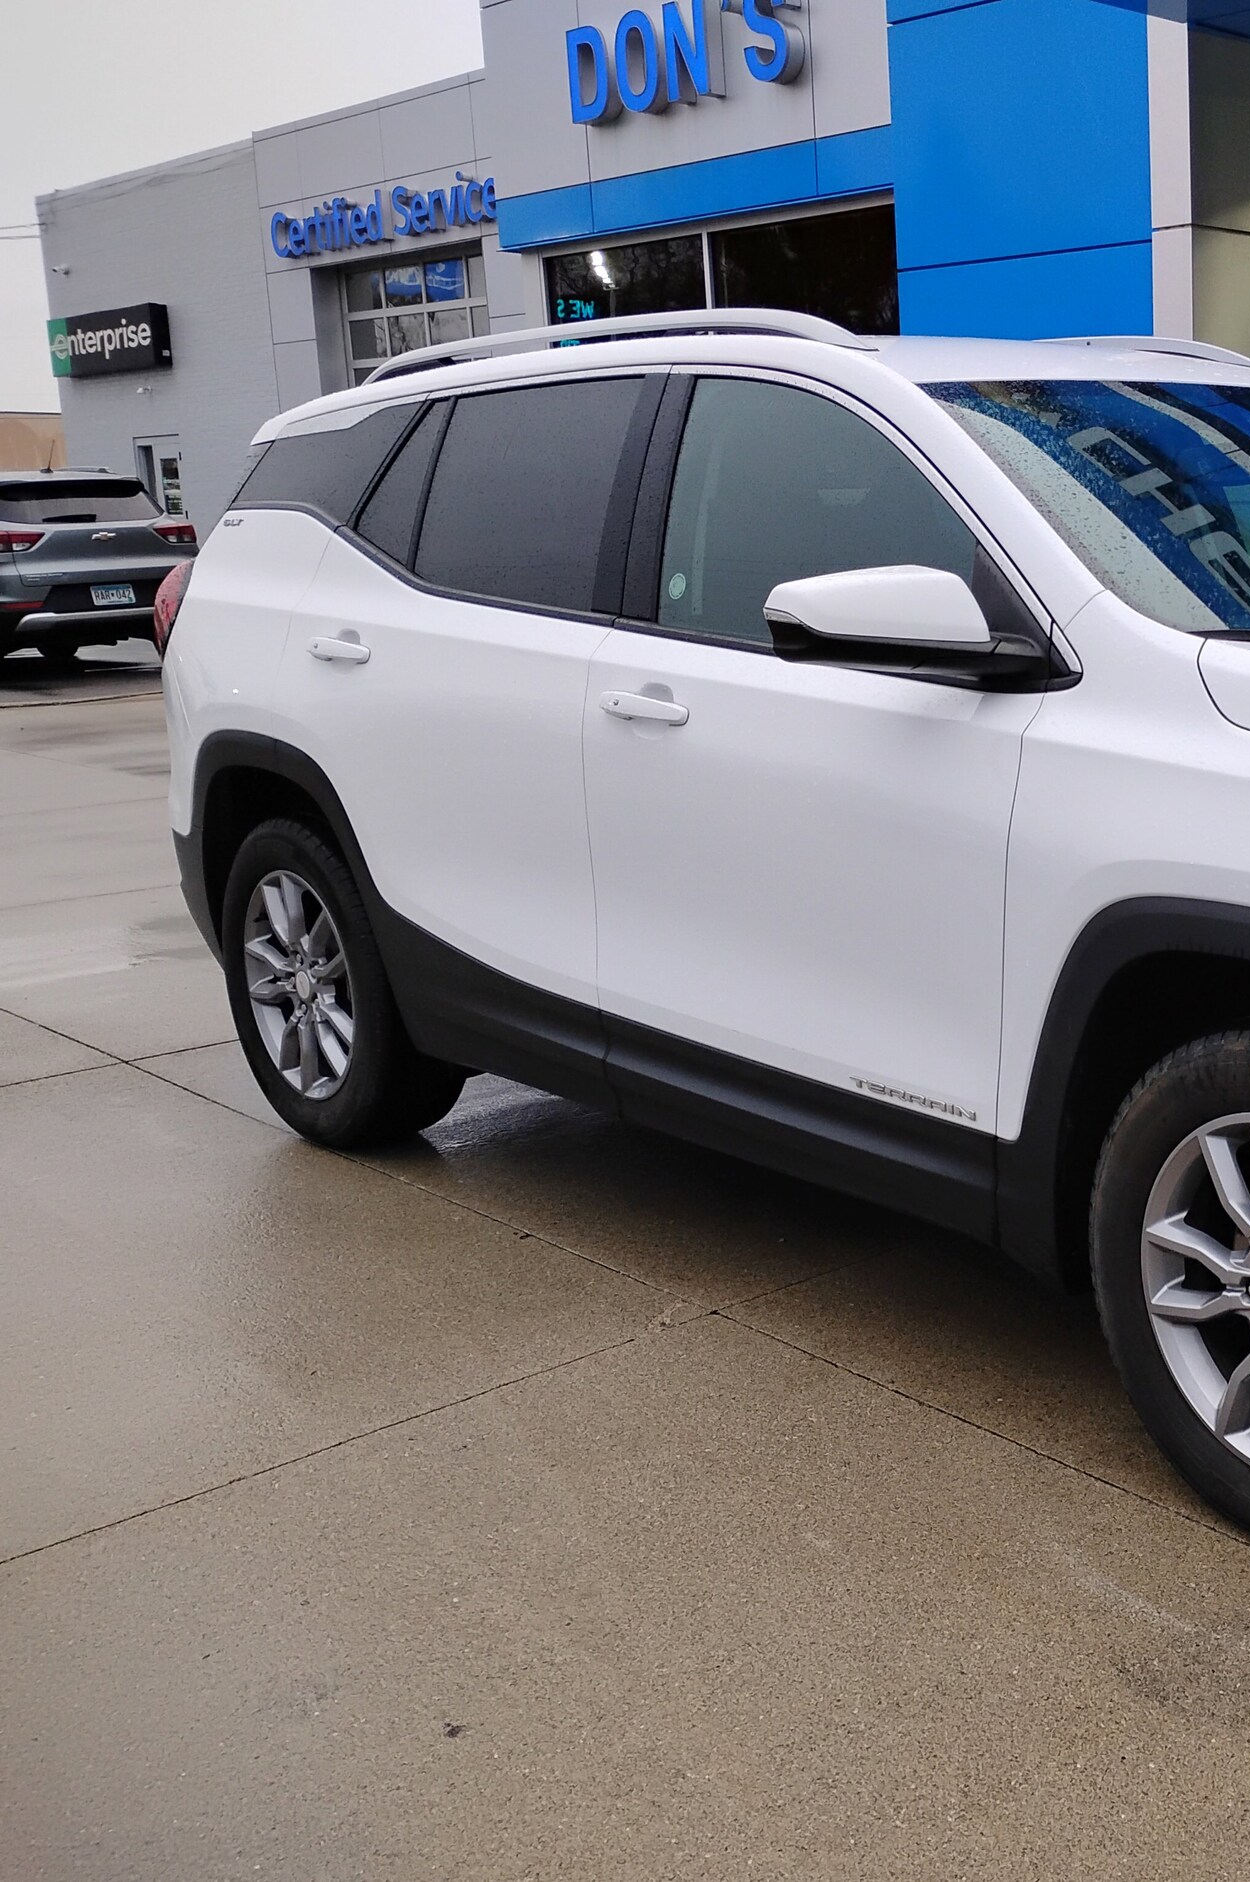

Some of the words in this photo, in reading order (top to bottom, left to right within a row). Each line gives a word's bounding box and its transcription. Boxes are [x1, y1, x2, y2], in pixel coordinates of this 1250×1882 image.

[271, 189, 383, 258] Certified
[391, 170, 497, 236] Service
[51, 318, 151, 360] enterprise
[849, 1075, 977, 1121] TERRAIN
